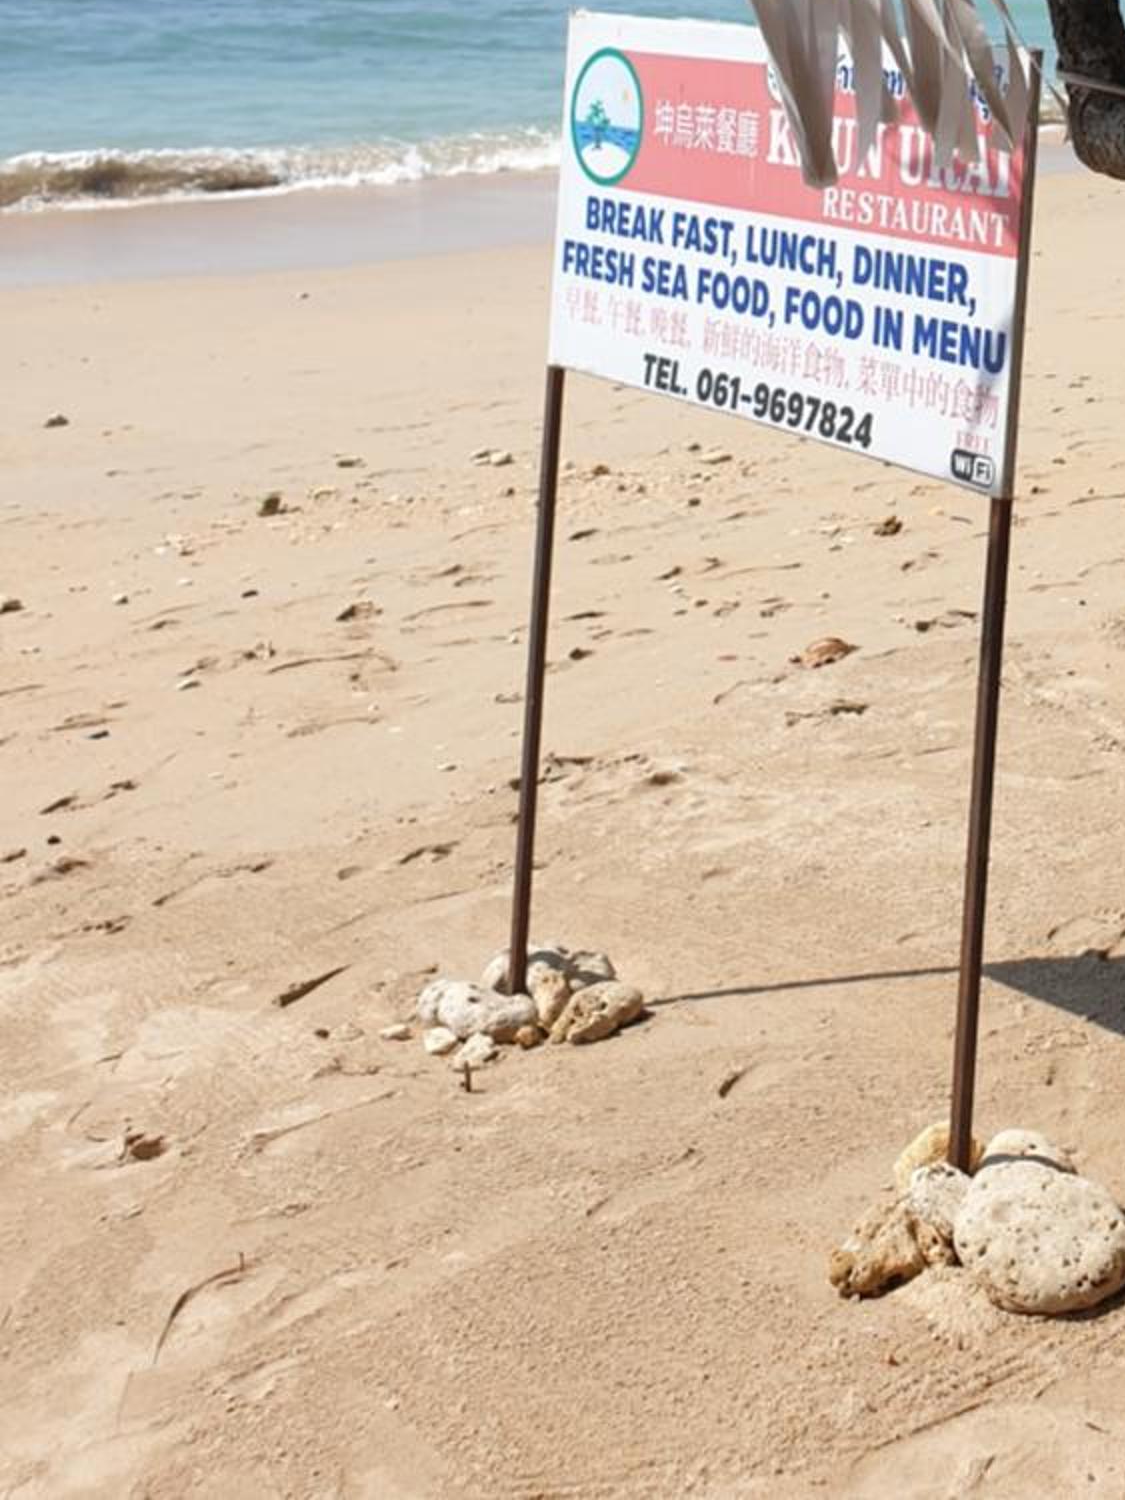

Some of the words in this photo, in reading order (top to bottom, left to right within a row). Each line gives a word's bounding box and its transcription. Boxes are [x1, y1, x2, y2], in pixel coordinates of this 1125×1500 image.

[766, 108, 883, 180] KUN
[586, 196, 665, 244] BREAK
[671, 212, 737, 266] FAST,
[746, 225, 843, 288] LUNCH,
[853, 245, 976, 317] DINNER,
[822, 187, 1009, 247] RESTAURANT
[562, 240, 635, 288] FRESH
[641, 257, 689, 301] SEA
[697, 268, 775, 328] FOOD,
[785, 286, 864, 340] FOOD
[873, 306, 904, 351] IN
[912, 314, 1007, 374] MENU
[643, 353, 688, 395] TEL.
[696, 368, 873, 449] 061-9697824
